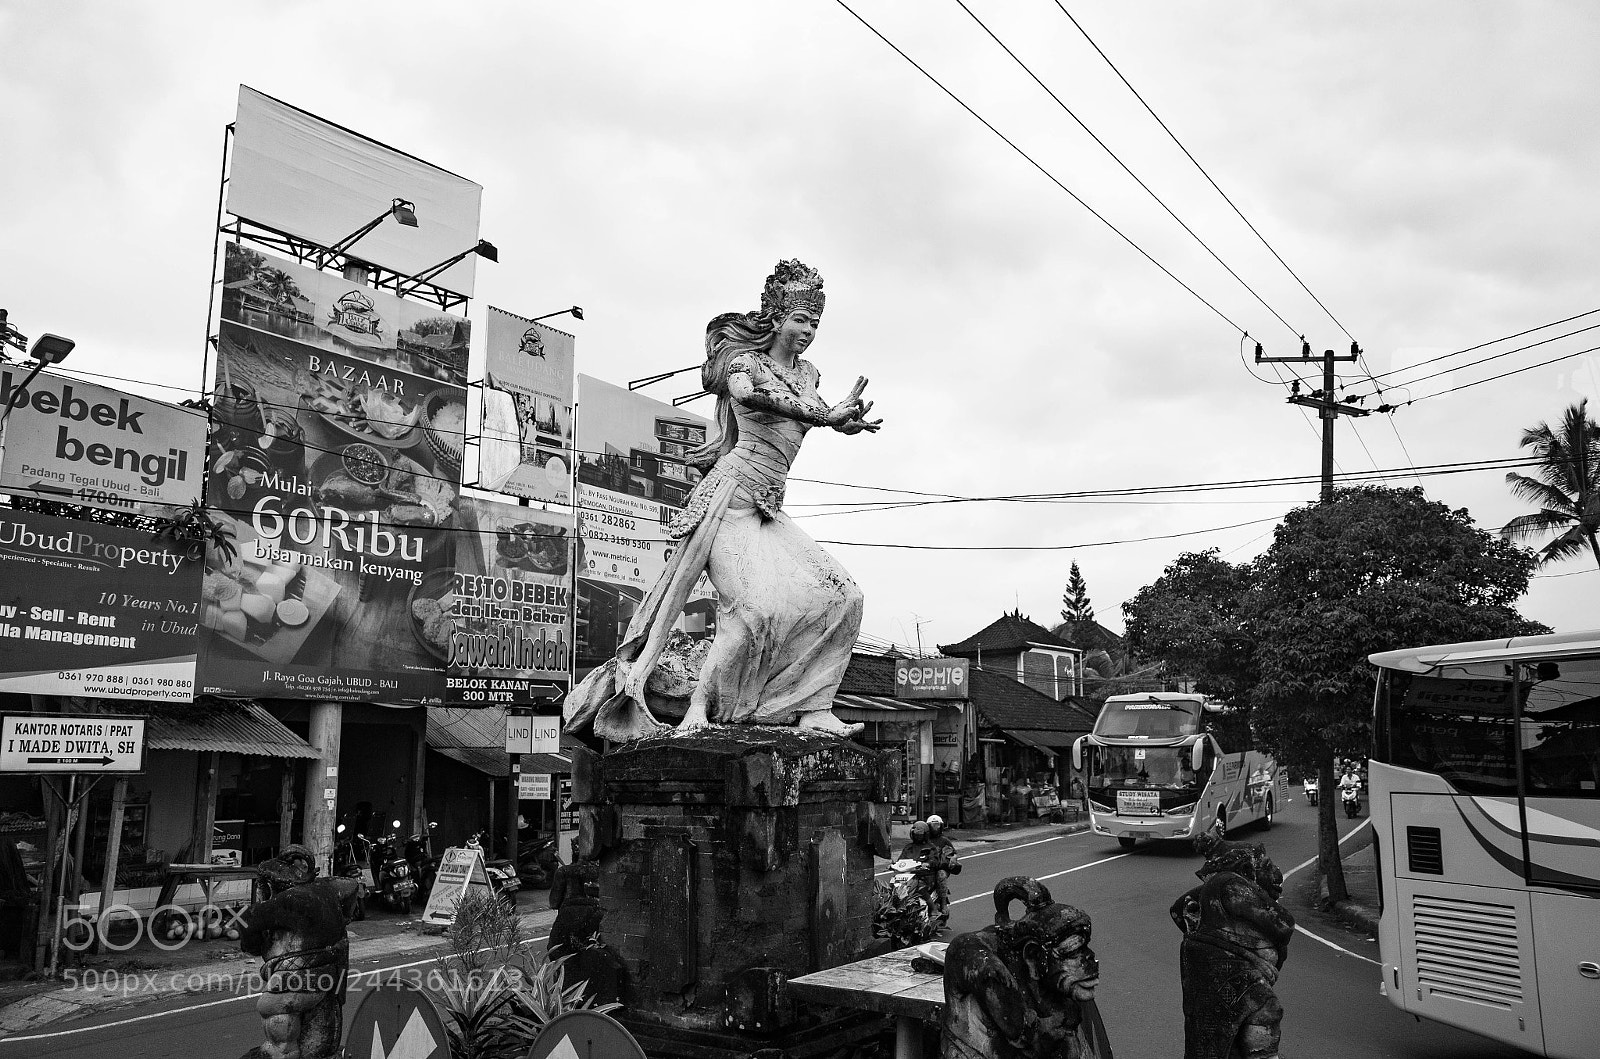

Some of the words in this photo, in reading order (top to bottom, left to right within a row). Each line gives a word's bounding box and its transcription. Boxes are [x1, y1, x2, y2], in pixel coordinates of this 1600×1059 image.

[308, 355, 405, 397] BAZAAR
[0, 370, 145, 435] bebek
[55, 424, 188, 487] bengil
[21, 464, 66, 483] Padang
[69, 473, 99, 487] Tegal
[102, 479, 130, 492] Ubud
[140, 485, 160, 497] Bali
[259, 471, 313, 497] Mulai
[580, 511, 599, 523] 0361
[601, 513, 636, 531] 282862
[632, 539, 651, 551] 5300
[41, 558, 72, 568] Specialist
[253, 539, 291, 563] bisa
[296, 551, 354, 573] makan
[359, 556, 424, 586] kenyang
[592, 549, 638, 564] www.metric.id
[453, 572, 508, 602] RESTO
[511, 579, 568, 608] BEBEK
[98, 592, 117, 606] 10
[121, 594, 161, 611] Years
[164, 599, 199, 616] No.1
[451, 600, 481, 618] dan
[30, 606, 65, 623] Sell
[77, 611, 117, 628] Rent
[24, 625, 137, 649] Management
[141, 620, 156, 632] in
[160, 620, 199, 637] Ubud
[514, 625, 568, 672] Indah
[58, 671, 82, 681] 0361
[86, 673, 104, 683] 970
[106, 674, 124, 684] 888
[132, 676, 154, 686] 0361
[157, 678, 174, 687] 980
[175, 680, 192, 688] 880
[274, 671, 295, 685] Raya
[297, 673, 315, 684] Goa
[317, 675, 344, 687] Gajah,
[346, 677, 372, 687] UBUD
[380, 679, 398, 689] BALI
[446, 678, 488, 690] BELOK
[490, 679, 530, 691] KANAN
[896, 666, 964, 686] SOPHIE
[83, 685, 192, 698] www.ubudproperty.com
[462, 691, 485, 702] 300
[488, 691, 515, 702] MTR
[14, 722, 58, 736] KANTOR
[60, 724, 103, 737] NOTARIS
[110, 725, 133, 737] PPAT
[508, 728, 529, 739] LIND
[534, 728, 557, 739] LIND
[8, 739, 15, 753] I
[19, 740, 61, 753] MADE
[65, 741, 114, 756] DWITA,
[117, 741, 136, 754] SH
